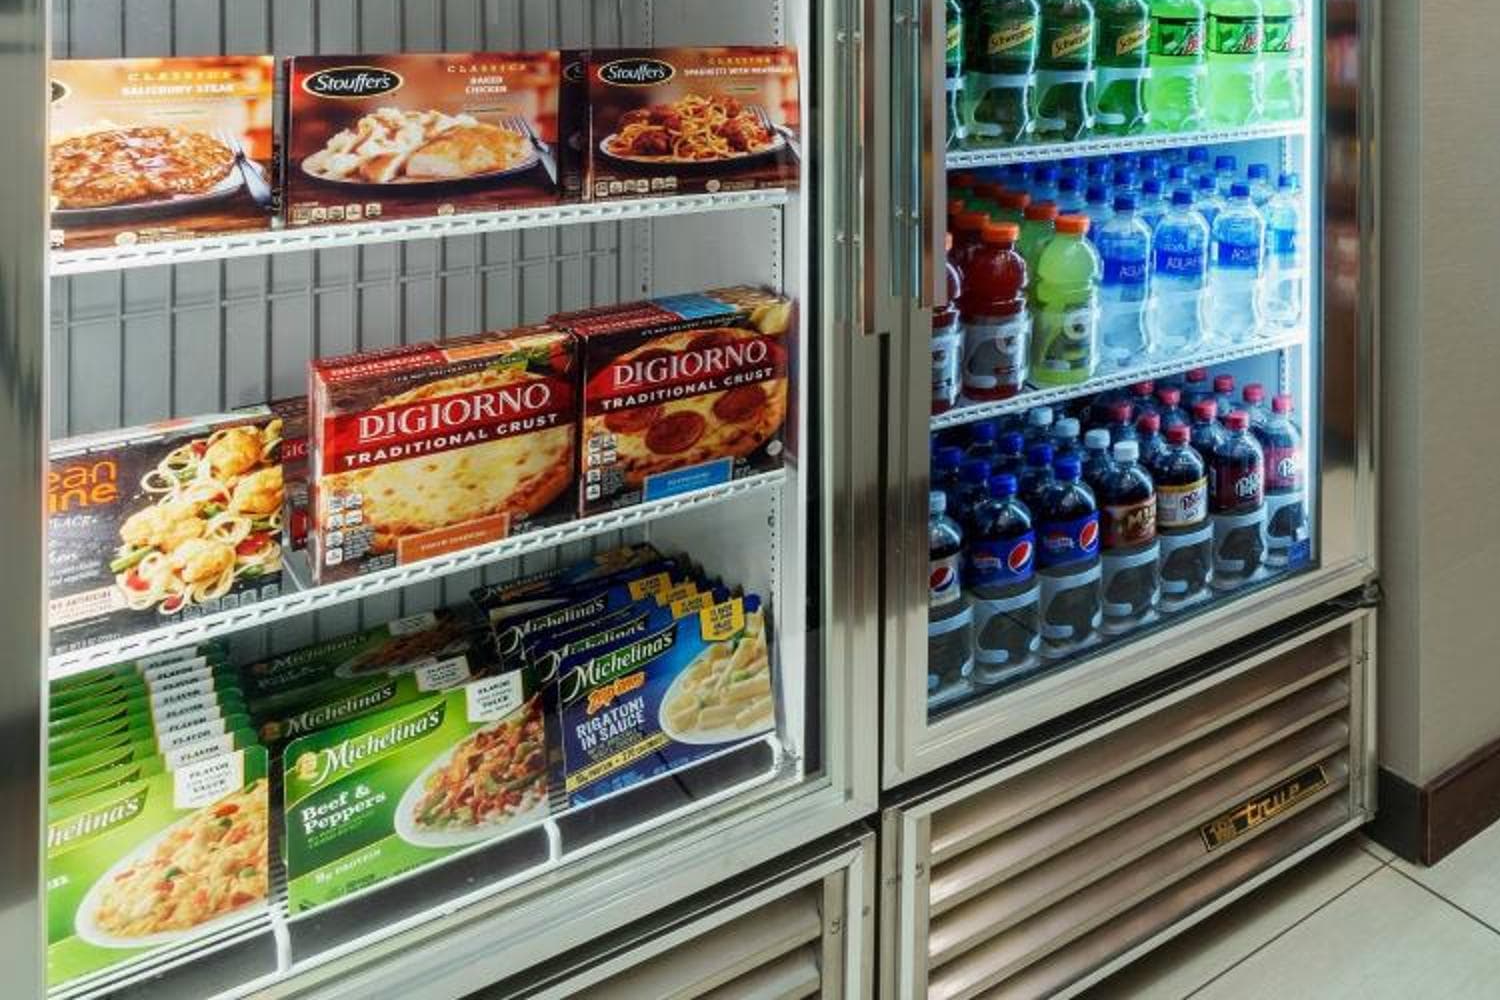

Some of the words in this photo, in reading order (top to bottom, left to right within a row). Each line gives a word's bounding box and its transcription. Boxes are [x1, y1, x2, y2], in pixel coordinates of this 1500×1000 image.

[315, 74, 392, 94] Stouffer's
[607, 63, 667, 82] Stouffer's
[612, 339, 768, 390] DIGIORNO
[601, 380, 718, 410] TRADITIONAL
[723, 366, 775, 388] CRUST
[358, 383, 552, 441] DIGIORNO
[344, 427, 489, 467] TRADITIONAL
[496, 412, 559, 436] CRUST
[48, 460, 118, 491] ean
[562, 629, 674, 703] Michelina's
[576, 695, 645, 739] RIGATONI
[581, 733, 598, 751] IN
[599, 710, 646, 741] SAUCE
[311, 707, 443, 788] Michelina's
[48, 794, 144, 850] helina's
[301, 790, 349, 824] Beef
[355, 783, 371, 800] &
[303, 791, 388, 836] Peppers
